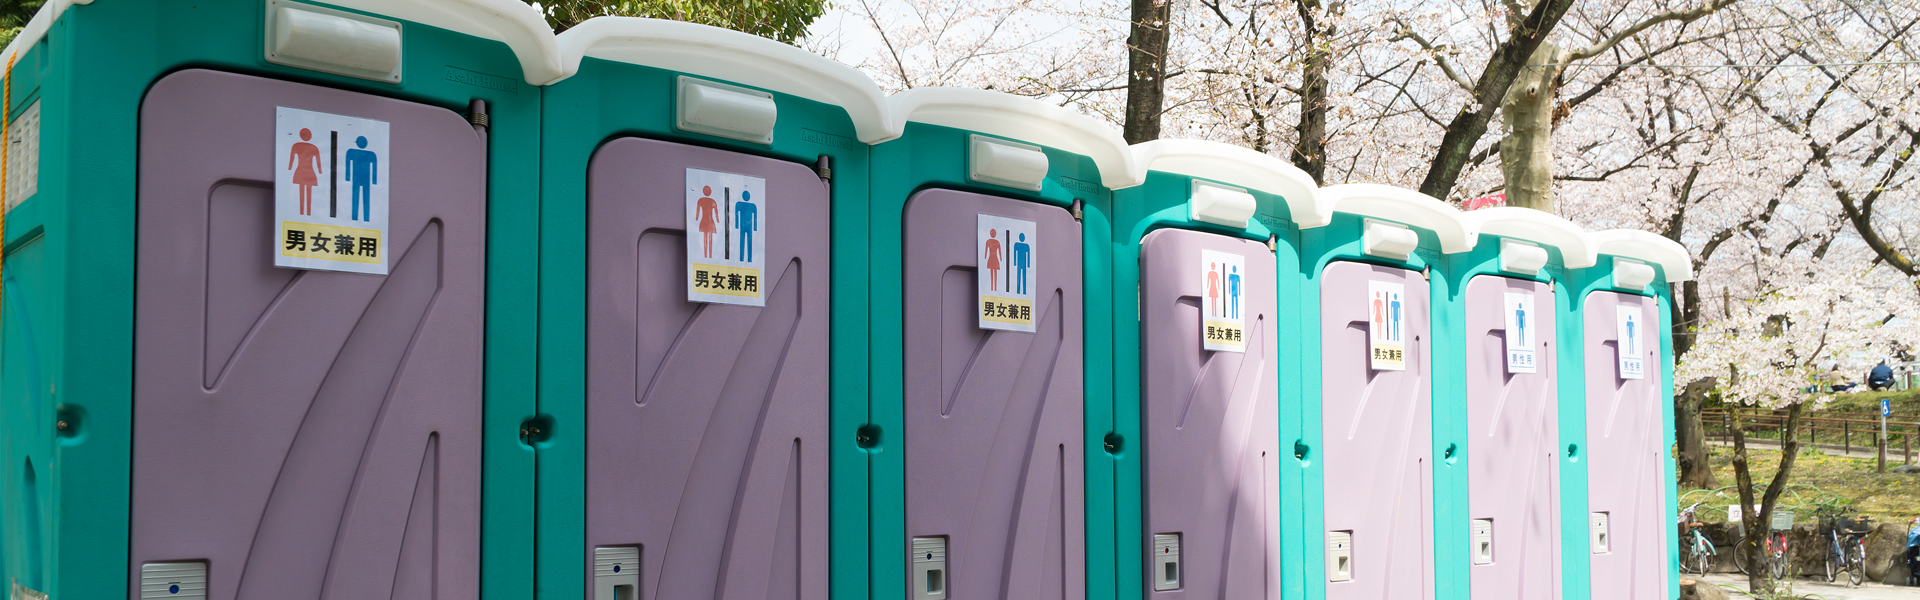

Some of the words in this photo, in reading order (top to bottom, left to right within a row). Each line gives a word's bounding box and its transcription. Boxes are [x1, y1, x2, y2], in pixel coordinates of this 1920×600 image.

[445, 69, 479, 87] Asahi
[481, 76, 517, 94] House
[285, 229, 377, 258] 男女兼用
[695, 270, 757, 292] 男女兼用
[984, 301, 1030, 321] 男女兼用
[1207, 325, 1242, 342] 男女兼用
[1374, 347, 1402, 362] 男女兼用
